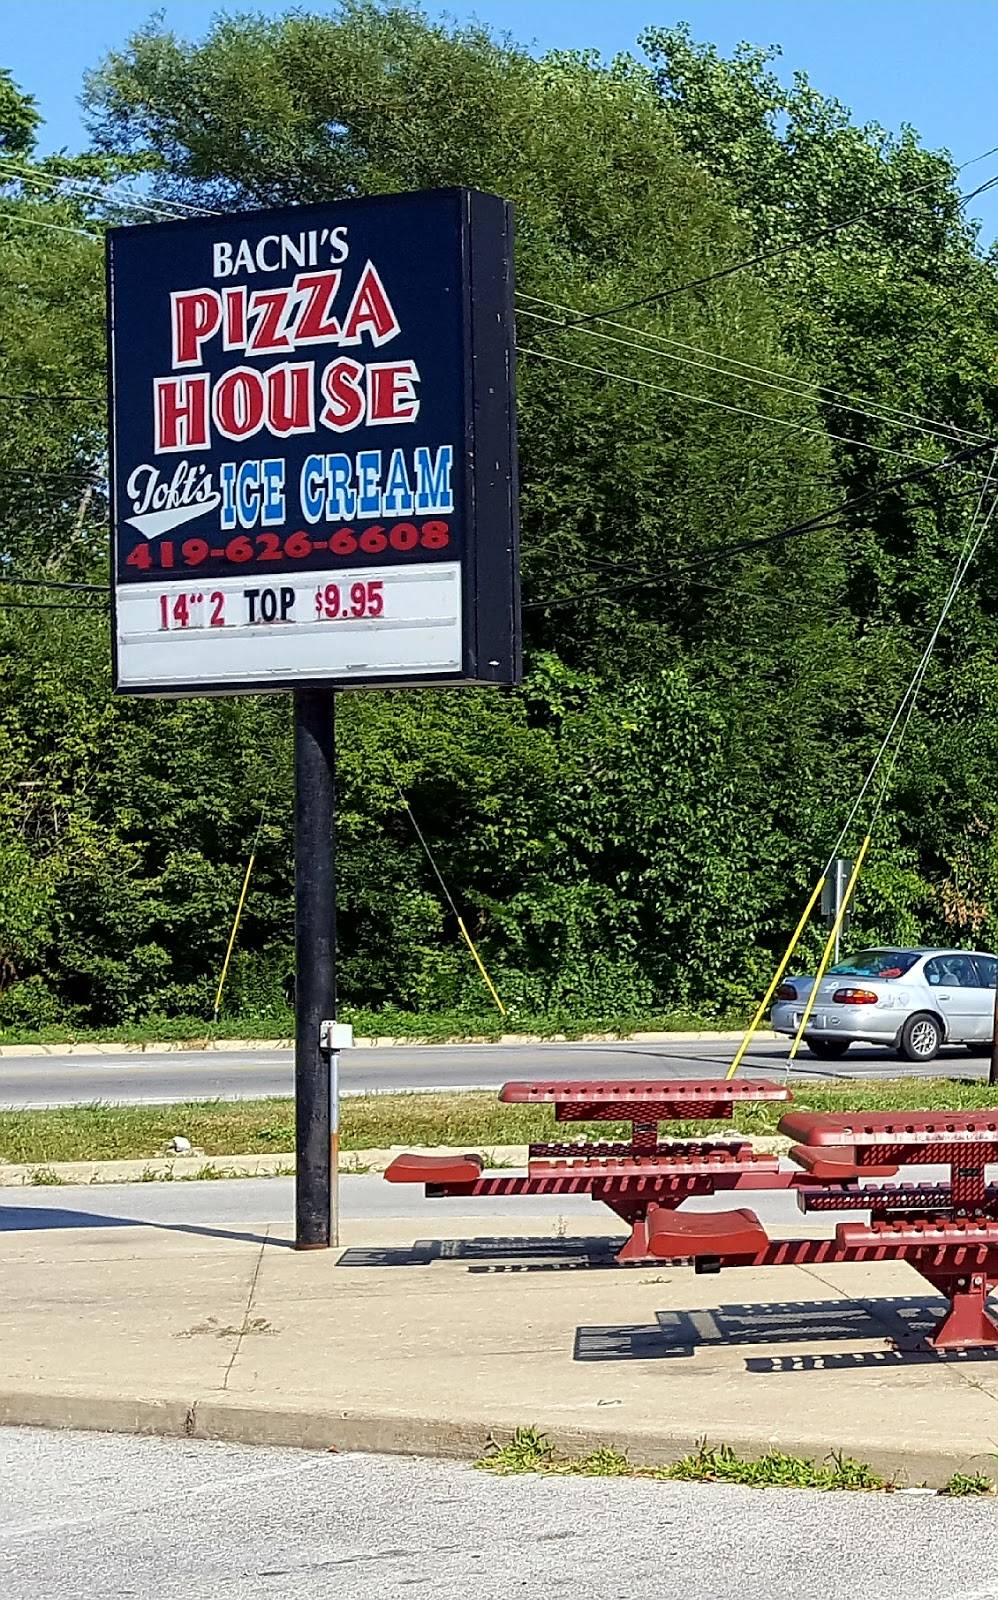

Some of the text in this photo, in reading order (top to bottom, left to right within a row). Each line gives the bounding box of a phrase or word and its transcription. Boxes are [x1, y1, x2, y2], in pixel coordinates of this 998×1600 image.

[212, 226, 349, 278] BACNI'S
[170, 258, 401, 369] PIZZA
[153, 356, 421, 454] HOUSE
[220, 458, 286, 530] ICE
[300, 445, 454, 525] CREAM
[126, 520, 450, 570] 419-626-6608
[210, 591, 225, 627] 2
[243, 587, 295, 623] TOP
[315, 581, 384, 622] $9.95
